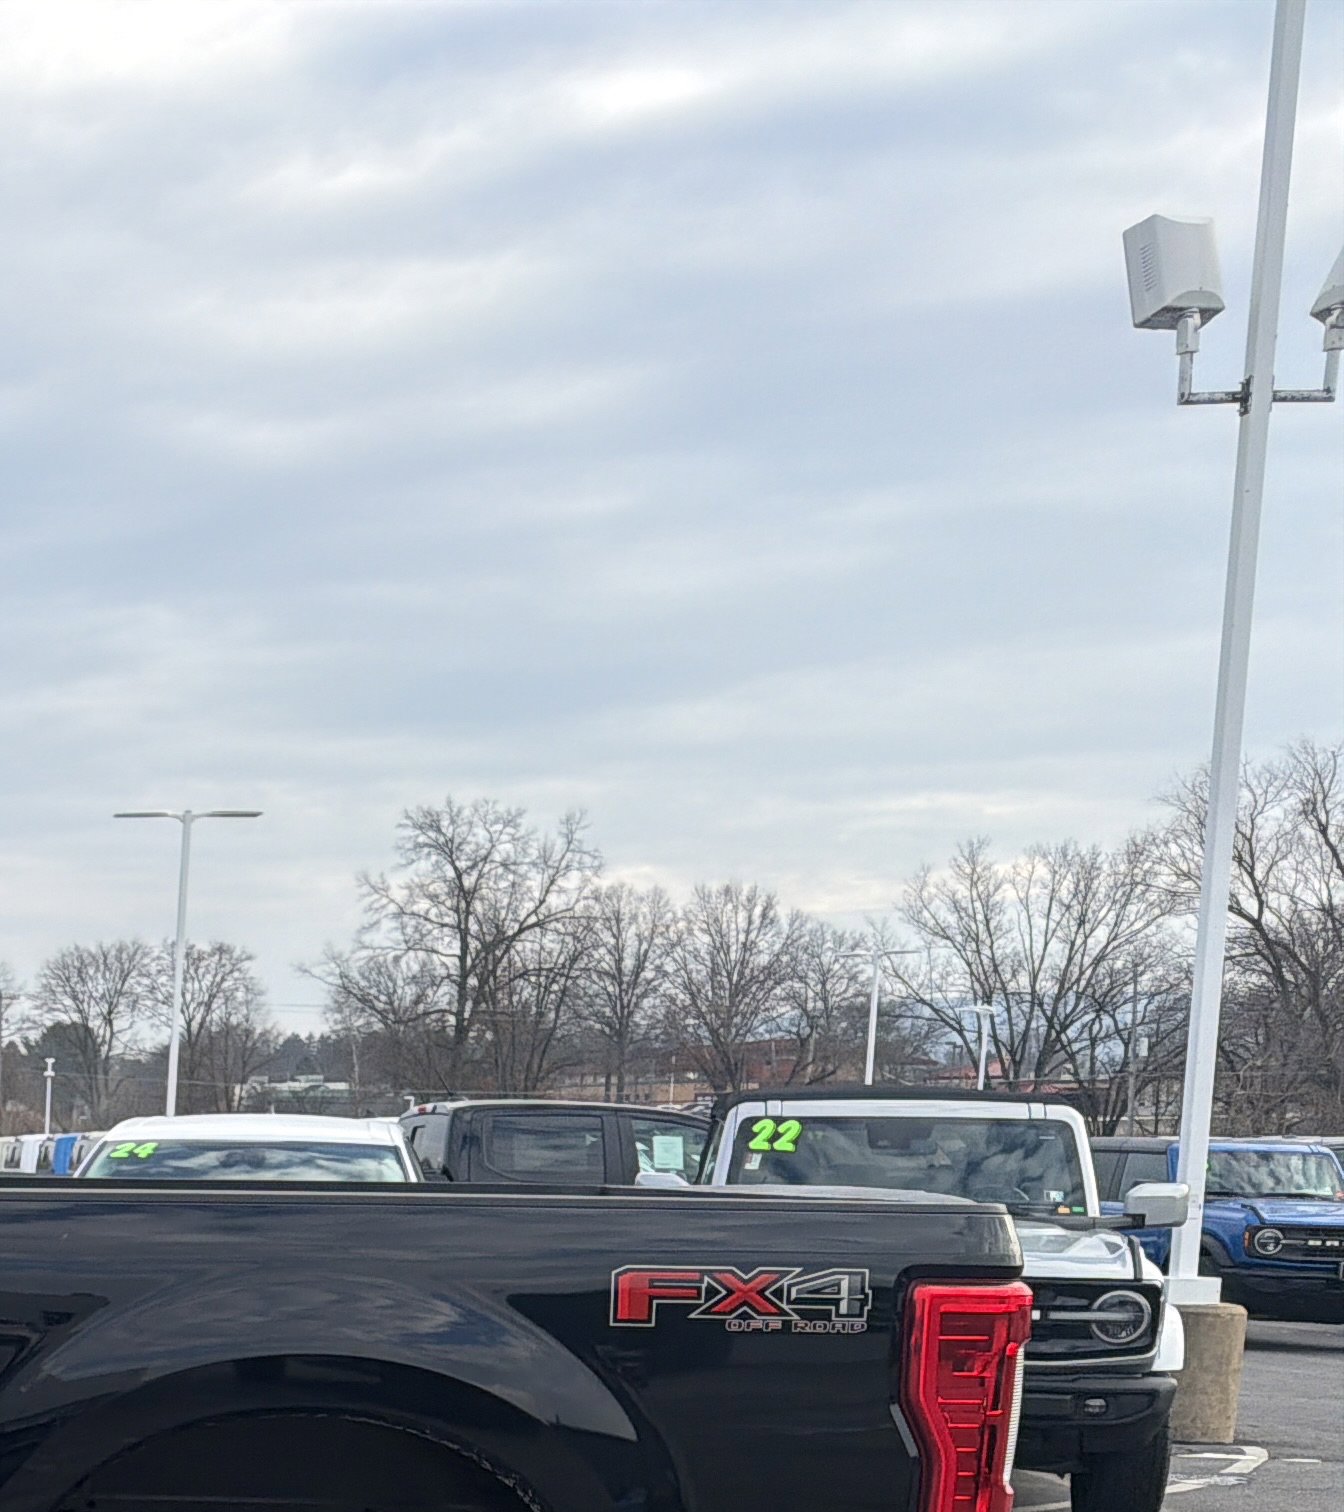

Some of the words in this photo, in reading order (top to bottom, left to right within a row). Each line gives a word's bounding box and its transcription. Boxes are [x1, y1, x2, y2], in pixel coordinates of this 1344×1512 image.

[748, 1118, 802, 1152] 22
[109, 1142, 159, 1159] 24
[610, 1265, 872, 1327] FX4
[725, 1319, 783, 1333] OFF
[791, 1320, 868, 1334] ROAD
